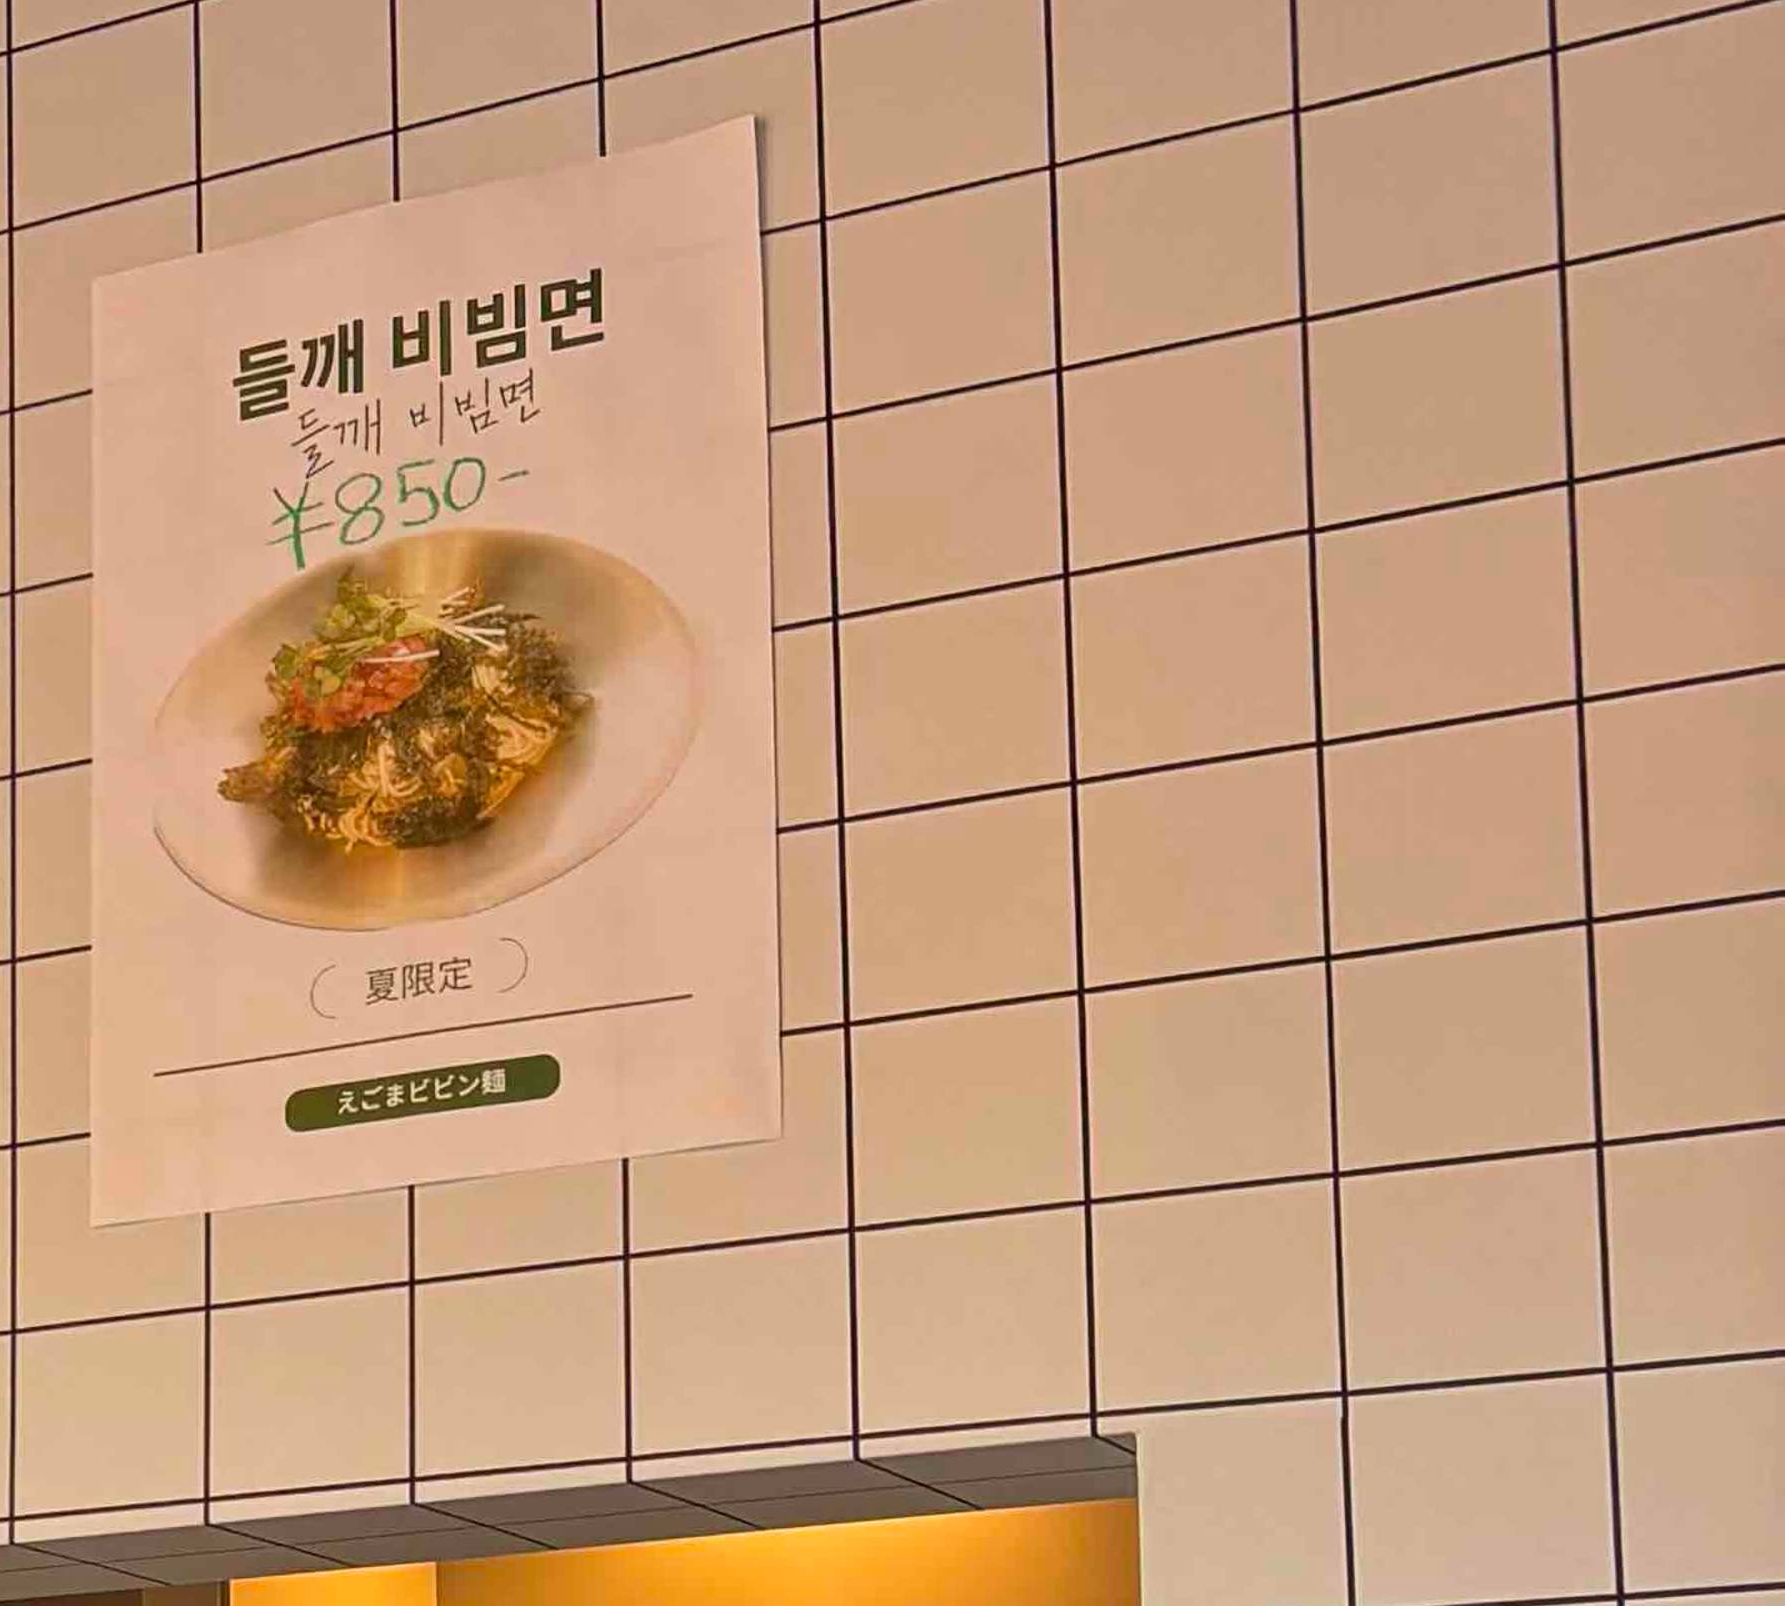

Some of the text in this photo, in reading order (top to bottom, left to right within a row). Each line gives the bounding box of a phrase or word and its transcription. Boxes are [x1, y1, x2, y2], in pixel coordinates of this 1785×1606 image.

[232, 268, 604, 421] 들깨 비빔면
[291, 367, 542, 479] 들깨 비빔면
[365, 957, 473, 1005] 夏限定
[337, 1069, 506, 1116] えごまビビン麺
